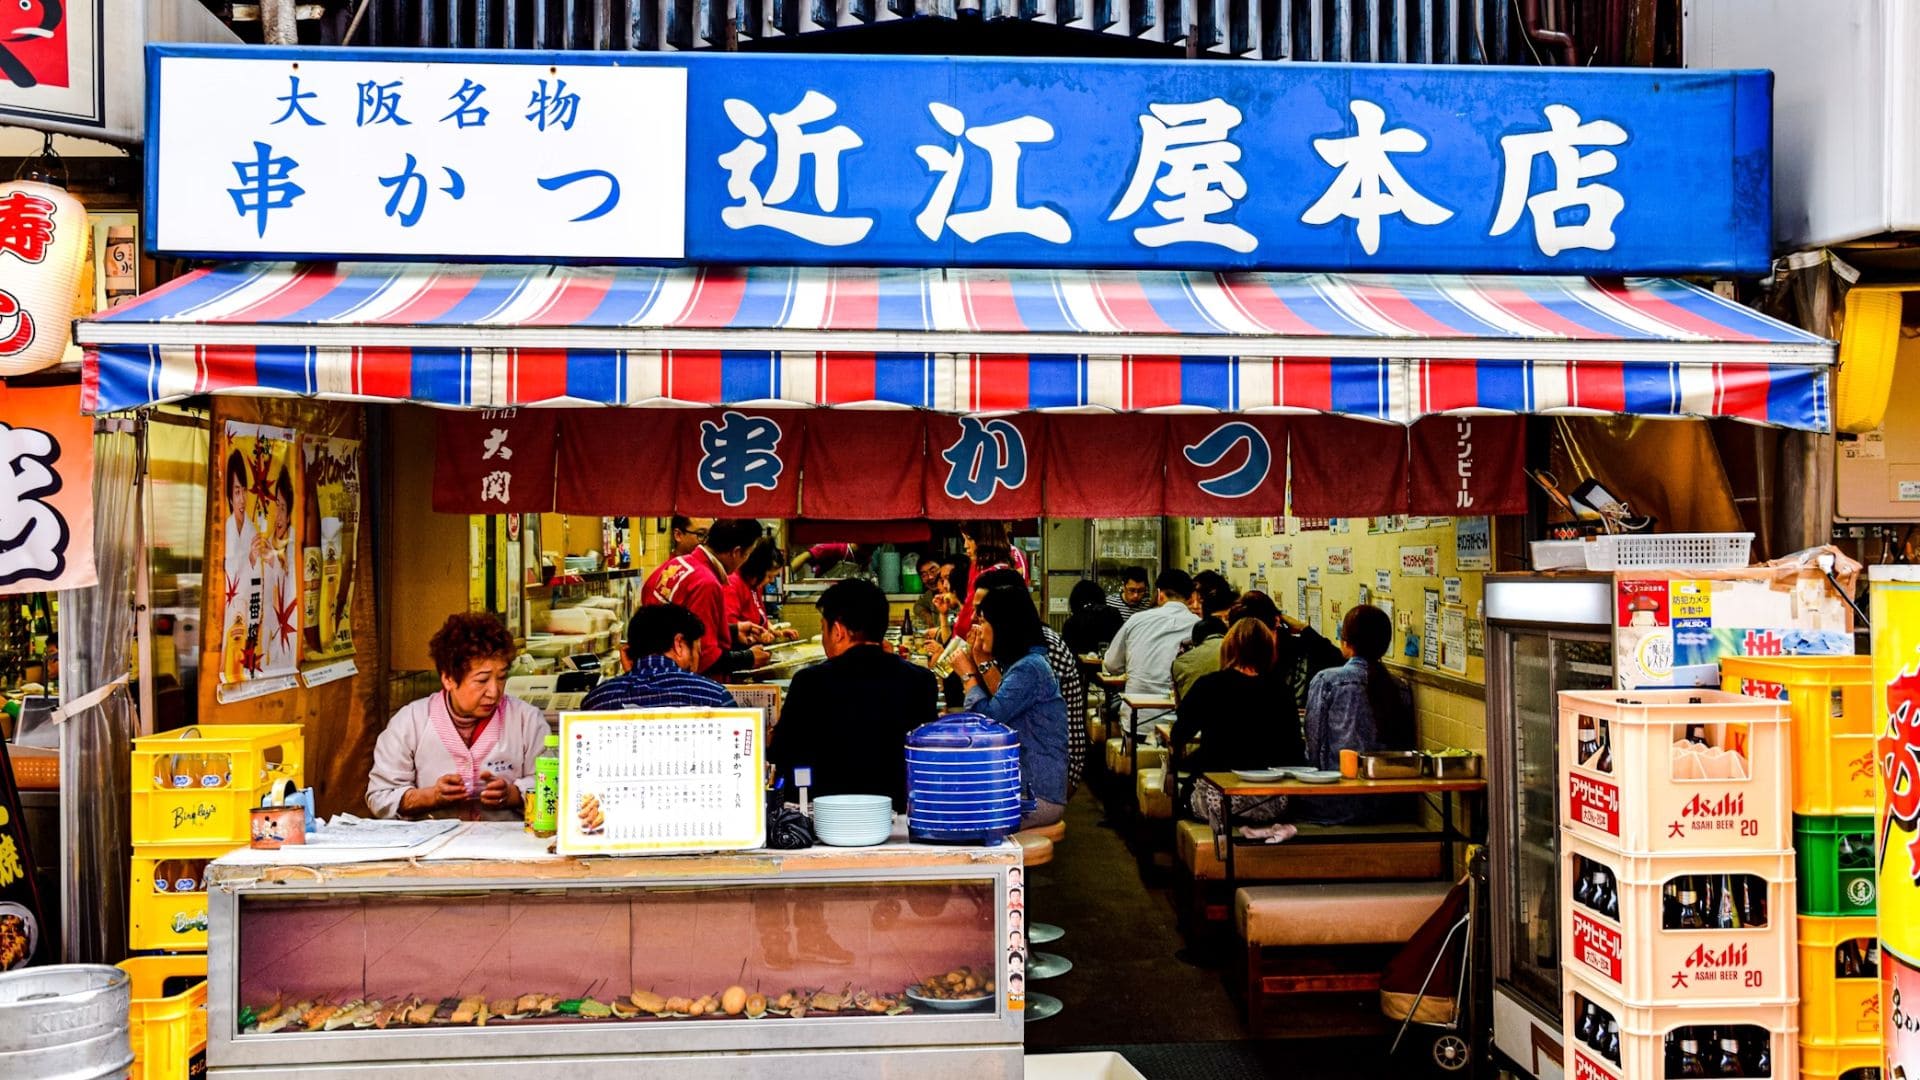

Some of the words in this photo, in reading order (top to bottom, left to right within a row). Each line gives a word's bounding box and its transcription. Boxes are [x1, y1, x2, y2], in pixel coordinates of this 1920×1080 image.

[270, 76, 581, 132] 大阪名物
[227, 141, 621, 239] 串かつ
[717, 90, 1629, 256] 近江屋本店
[697, 410, 1272, 506] 串かつ
[1457, 415, 1474, 509] リンビール
[1673, 596, 1710, 605] 防犯カメラ
[1680, 607, 1704, 616] 作動中
[1570, 776, 1619, 812] アサヒビール
[1682, 792, 1744, 817] Asahi
[1668, 820, 1685, 838] 大
[1692, 820, 1713, 830] ASAHI
[1716, 820, 1734, 830] BEER
[1741, 819, 1758, 836] 20
[1574, 915, 1622, 960] アサヒビール
[1685, 942, 1748, 968] Asahi
[1672, 971, 1688, 988] 大
[1695, 971, 1717, 981] ASAHI
[1720, 970, 1738, 981] BEER
[1745, 970, 1762, 987] 20
